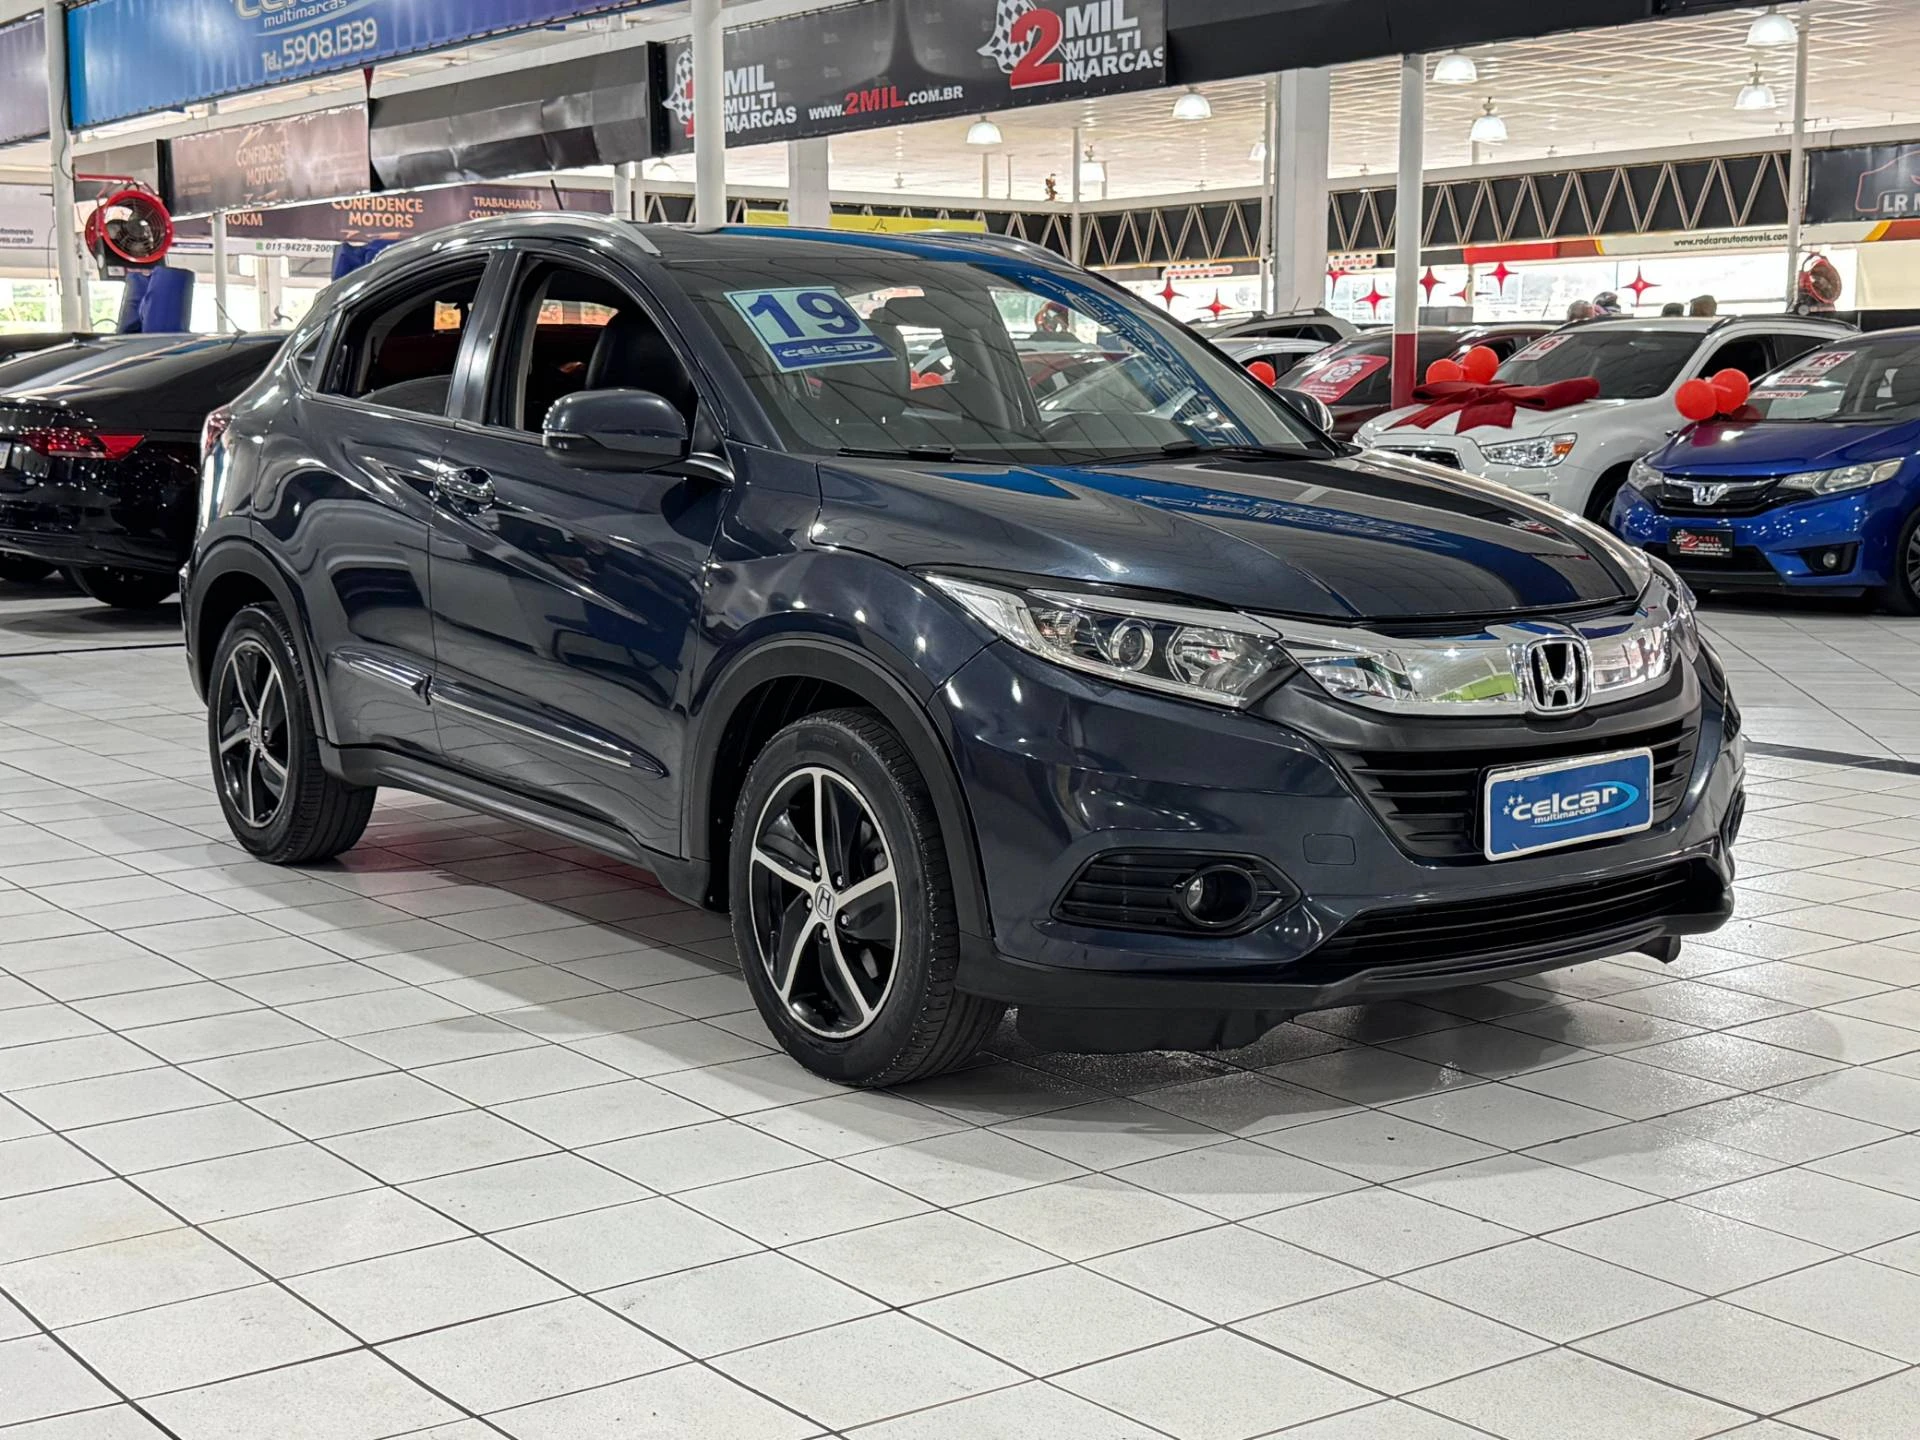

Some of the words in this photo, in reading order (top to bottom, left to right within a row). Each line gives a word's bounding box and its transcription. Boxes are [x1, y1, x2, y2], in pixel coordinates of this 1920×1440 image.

[264, 0, 346, 28] multimarcas
[283, 18, 377, 67] 5908.1339
[1010, 8, 1064, 90] 2
[1065, 0, 1138, 39] MIL
[1066, 29, 1141, 60] MULTI
[1065, 46, 1163, 82] MARCAS
[724, 64, 775, 96] MIL
[725, 91, 777, 114] MULTI
[725, 106, 797, 133] MARCAS
[246, 164, 285, 186] MOTORS
[331, 197, 424, 213] CONFIDENCE
[472, 196, 542, 210] TRABALHAMOS
[1883, 194, 1908, 213] LR
[349, 212, 414, 228] MOTORS
[748, 292, 860, 337] 19
[782, 343, 872, 358] celcar
[1512, 787, 1618, 821] celcar
[1534, 806, 1597, 824] multimarcas
